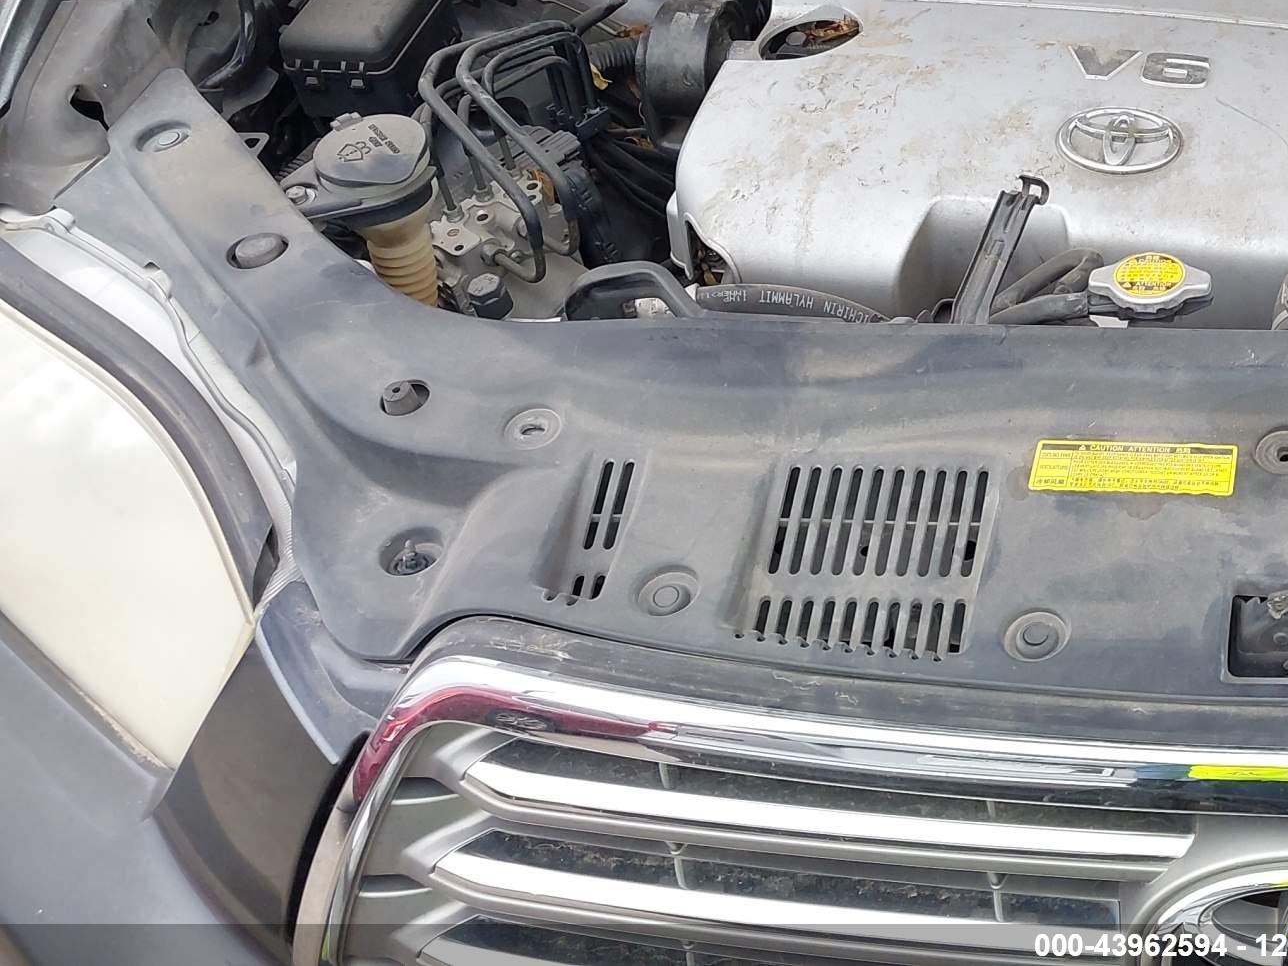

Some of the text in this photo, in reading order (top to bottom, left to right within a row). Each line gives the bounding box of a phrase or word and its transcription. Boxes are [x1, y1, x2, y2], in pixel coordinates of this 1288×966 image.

[1067, 43, 1212, 90] V6
[759, 289, 815, 310] HYLAMMIT
[1089, 444, 1124, 452] CAUTION
[1128, 445, 1171, 454] ATTENTION
